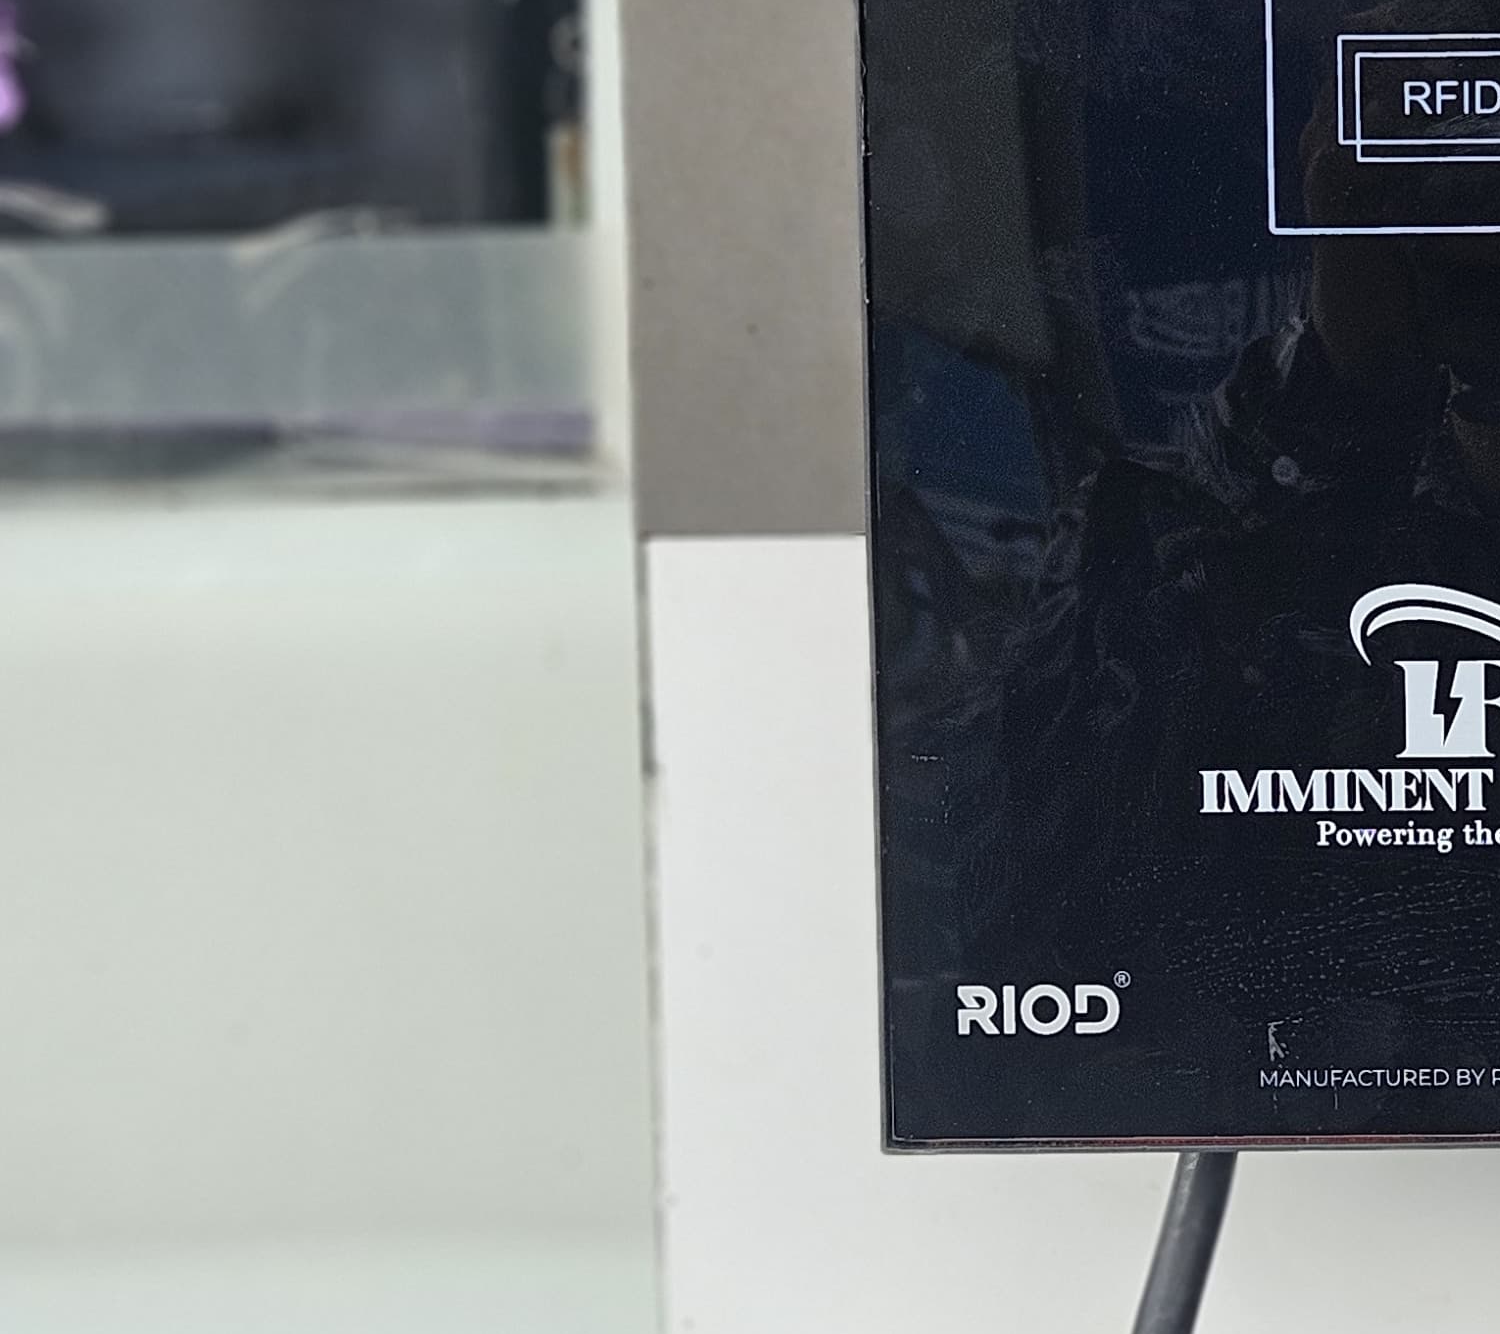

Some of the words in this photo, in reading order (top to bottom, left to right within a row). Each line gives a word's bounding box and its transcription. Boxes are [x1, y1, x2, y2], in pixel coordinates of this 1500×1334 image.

[1199, 768, 1494, 813] IMMINENT
[1316, 820, 1454, 853] Powering
[1260, 1069, 1450, 1088] MANUFACTURED
[1456, 1068, 1486, 1087] BY
